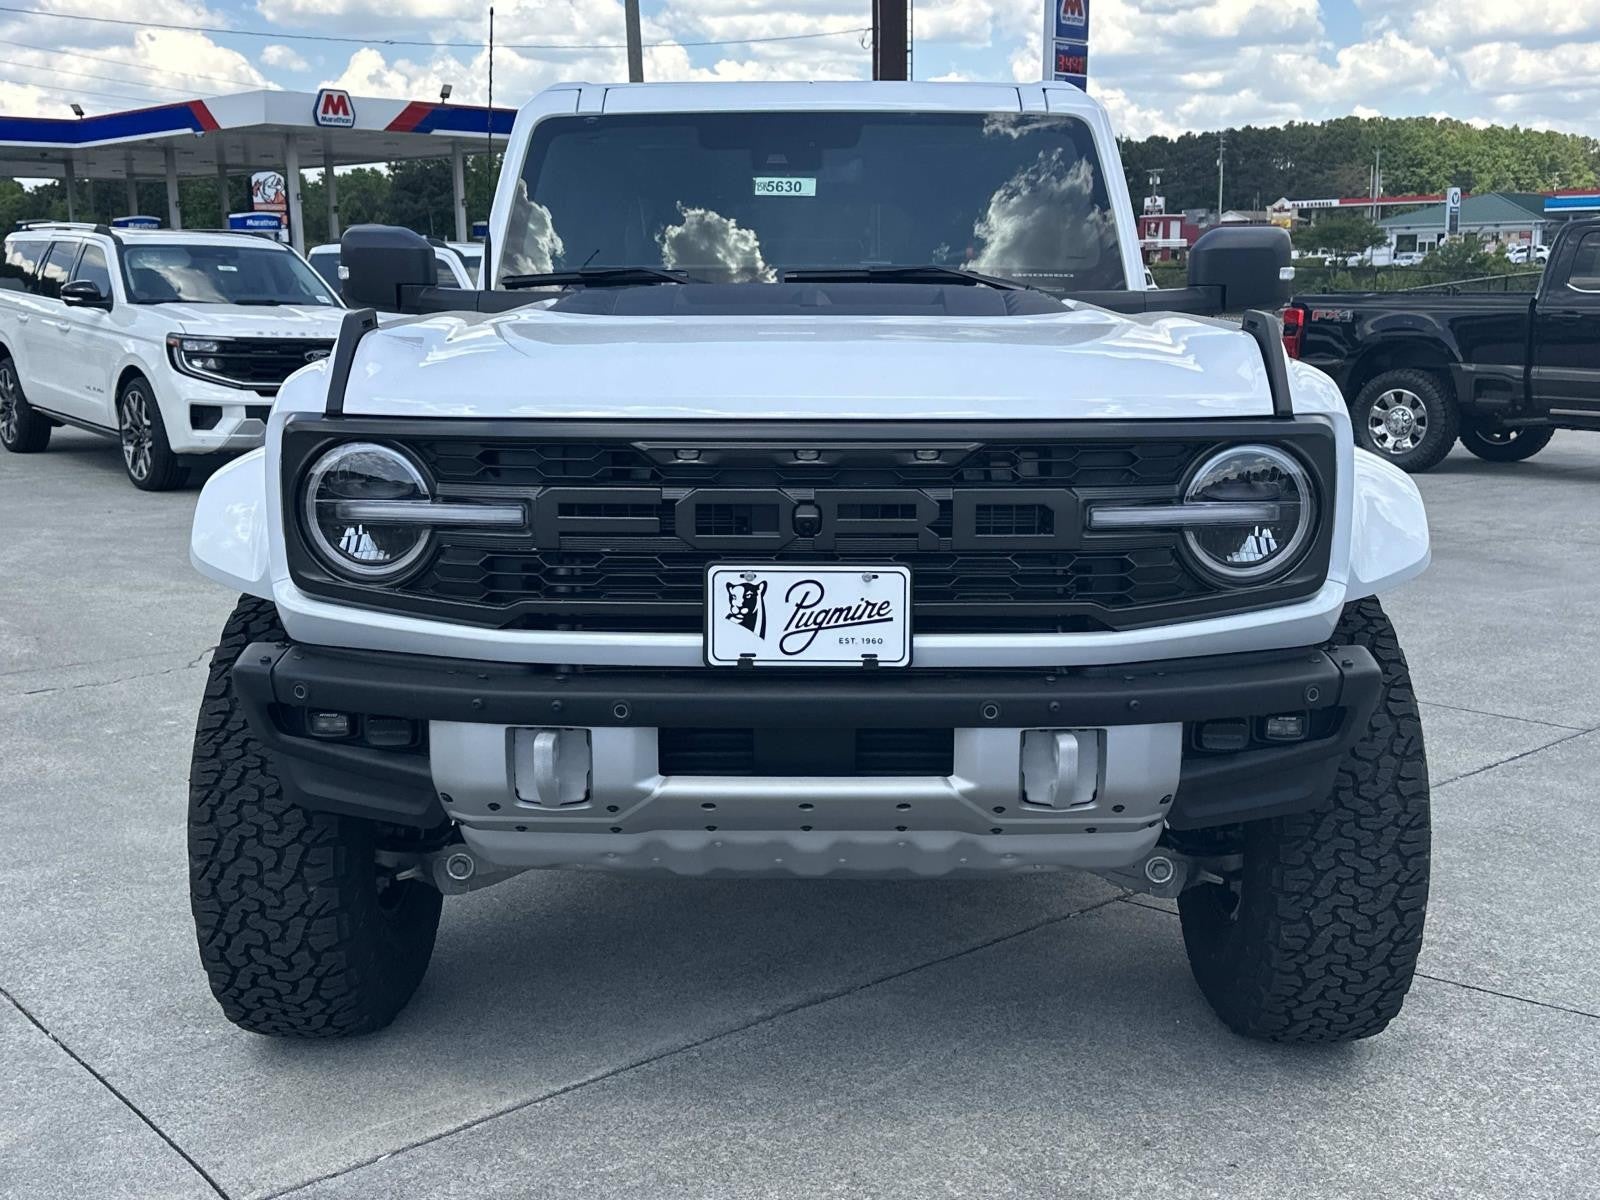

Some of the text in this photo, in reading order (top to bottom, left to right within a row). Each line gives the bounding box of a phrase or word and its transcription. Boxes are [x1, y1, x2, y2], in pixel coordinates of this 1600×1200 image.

[322, 94, 349, 116] M
[766, 181, 802, 192] 5630
[246, 218, 278, 227] Marathon
[1312, 309, 1353, 323] FX4
[536, 487, 1081, 551] FORD
[779, 579, 894, 656] Pugmire
[838, 637, 884, 645] EST. 1960
